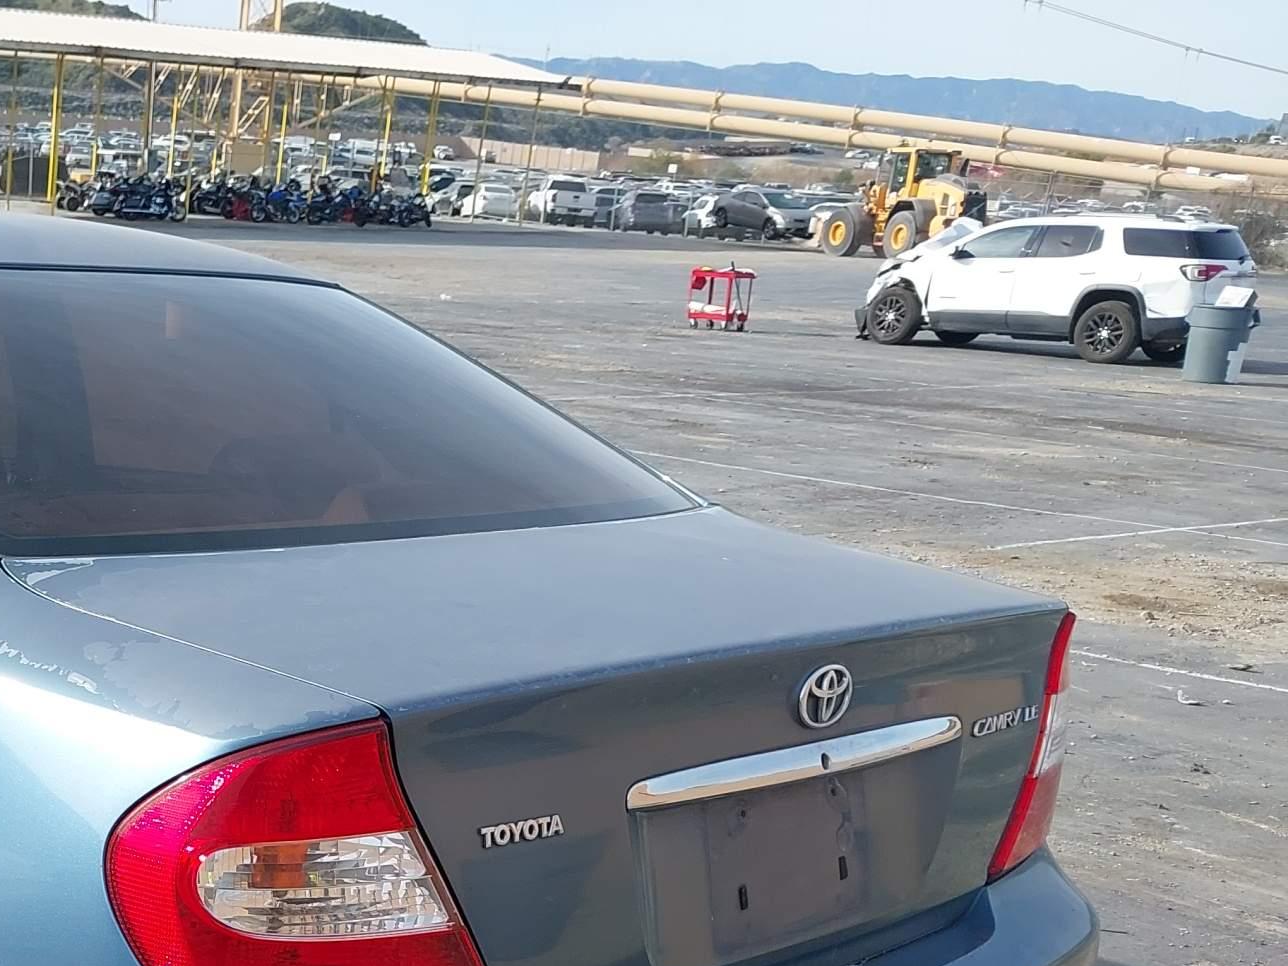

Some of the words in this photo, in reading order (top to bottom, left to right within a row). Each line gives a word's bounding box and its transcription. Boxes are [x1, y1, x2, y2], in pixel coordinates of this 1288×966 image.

[972, 707, 1021, 737] CAMRY
[1023, 704, 1039, 722] LE
[480, 814, 565, 849] TOYOTA
